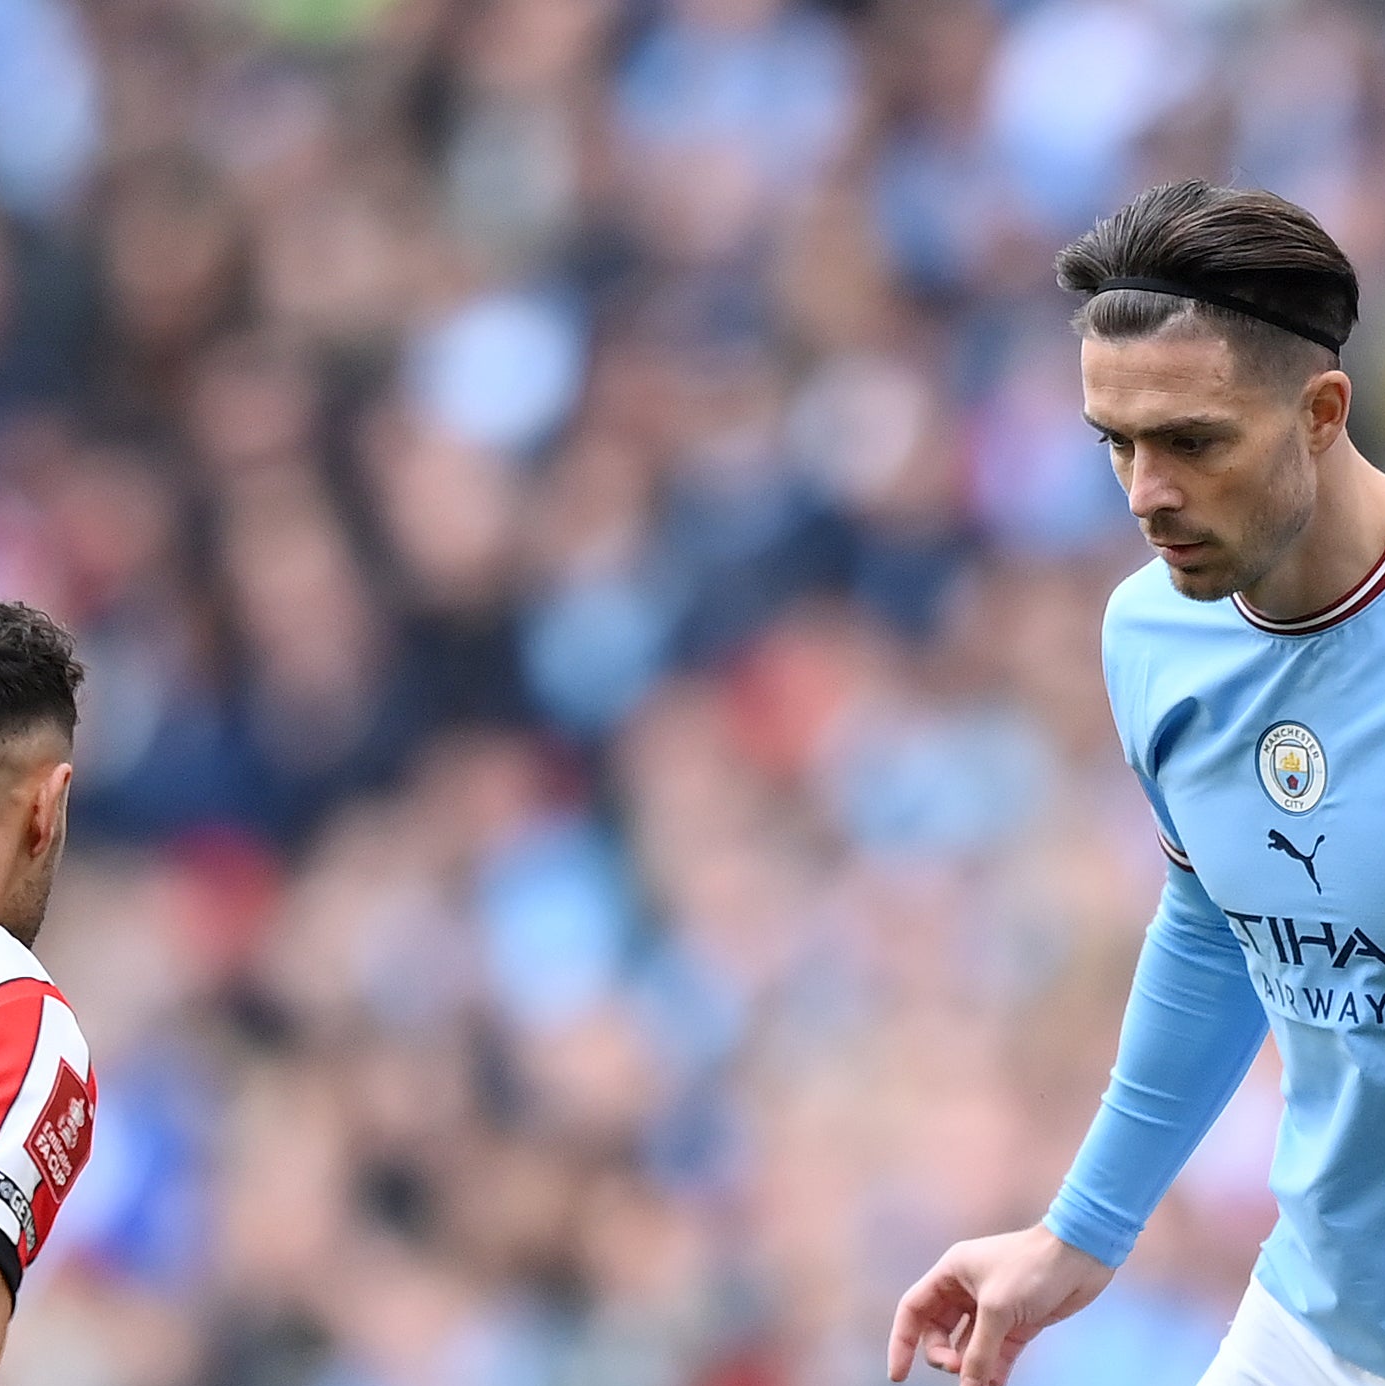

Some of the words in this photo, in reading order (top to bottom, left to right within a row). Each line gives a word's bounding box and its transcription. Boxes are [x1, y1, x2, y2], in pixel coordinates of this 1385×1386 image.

[1264, 728, 1320, 759] MANCHESTER
[1284, 799, 1304, 809] CITY
[35, 1133, 51, 1158] FA
[47, 1157, 67, 1186] CUP
